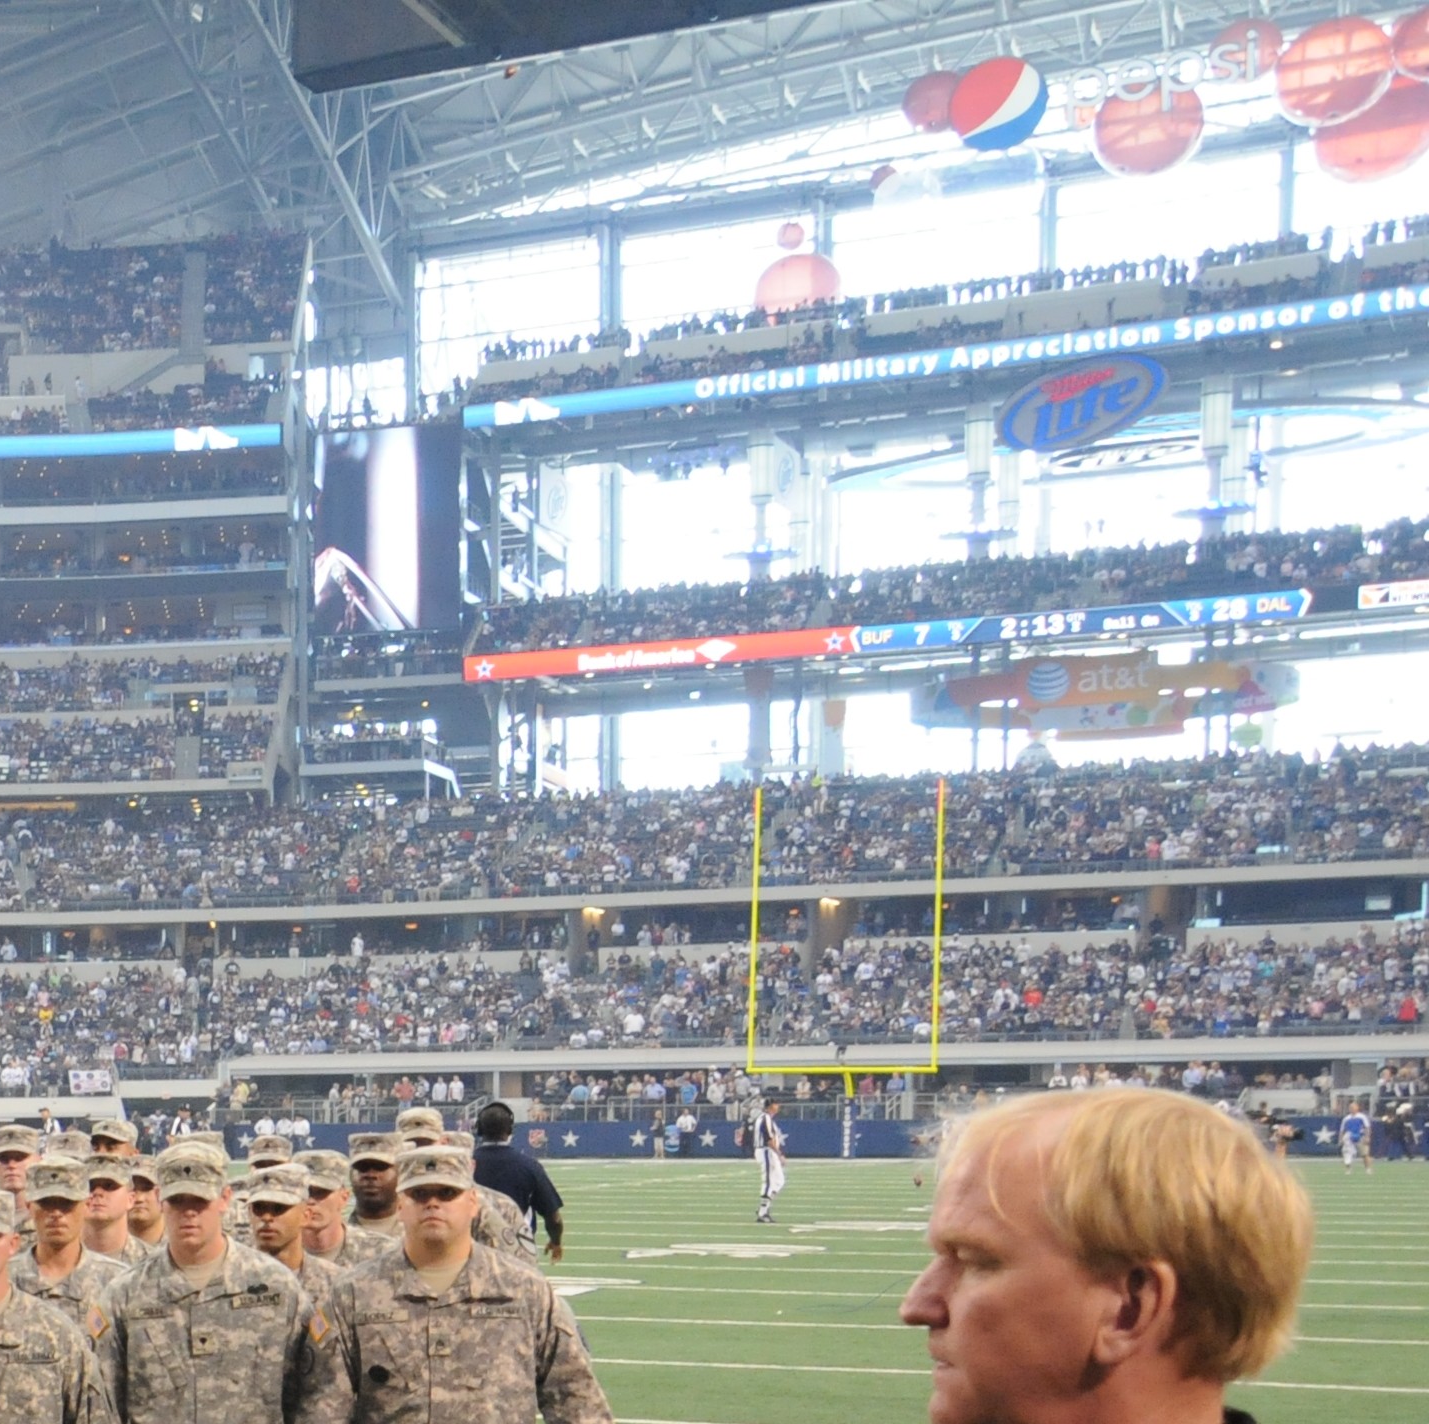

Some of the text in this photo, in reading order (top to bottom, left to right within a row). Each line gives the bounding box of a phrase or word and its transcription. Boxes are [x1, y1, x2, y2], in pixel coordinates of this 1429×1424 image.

[1067, 29, 1260, 128] pepsi
[695, 366, 806, 399] Official
[816, 351, 939, 386] Military
[949, 326, 1161, 371] Appreciation
[1173, 302, 1316, 342] Sponsor
[1328, 292, 1364, 322] of
[1031, 376, 1139, 448] Lite
[1256, 596, 1291, 612] DAL
[861, 625, 930, 646] BUF 7
[1000, 613, 1065, 639] 2:13
[578, 646, 696, 671] Bank of America
[1077, 661, 1150, 692] at&t
